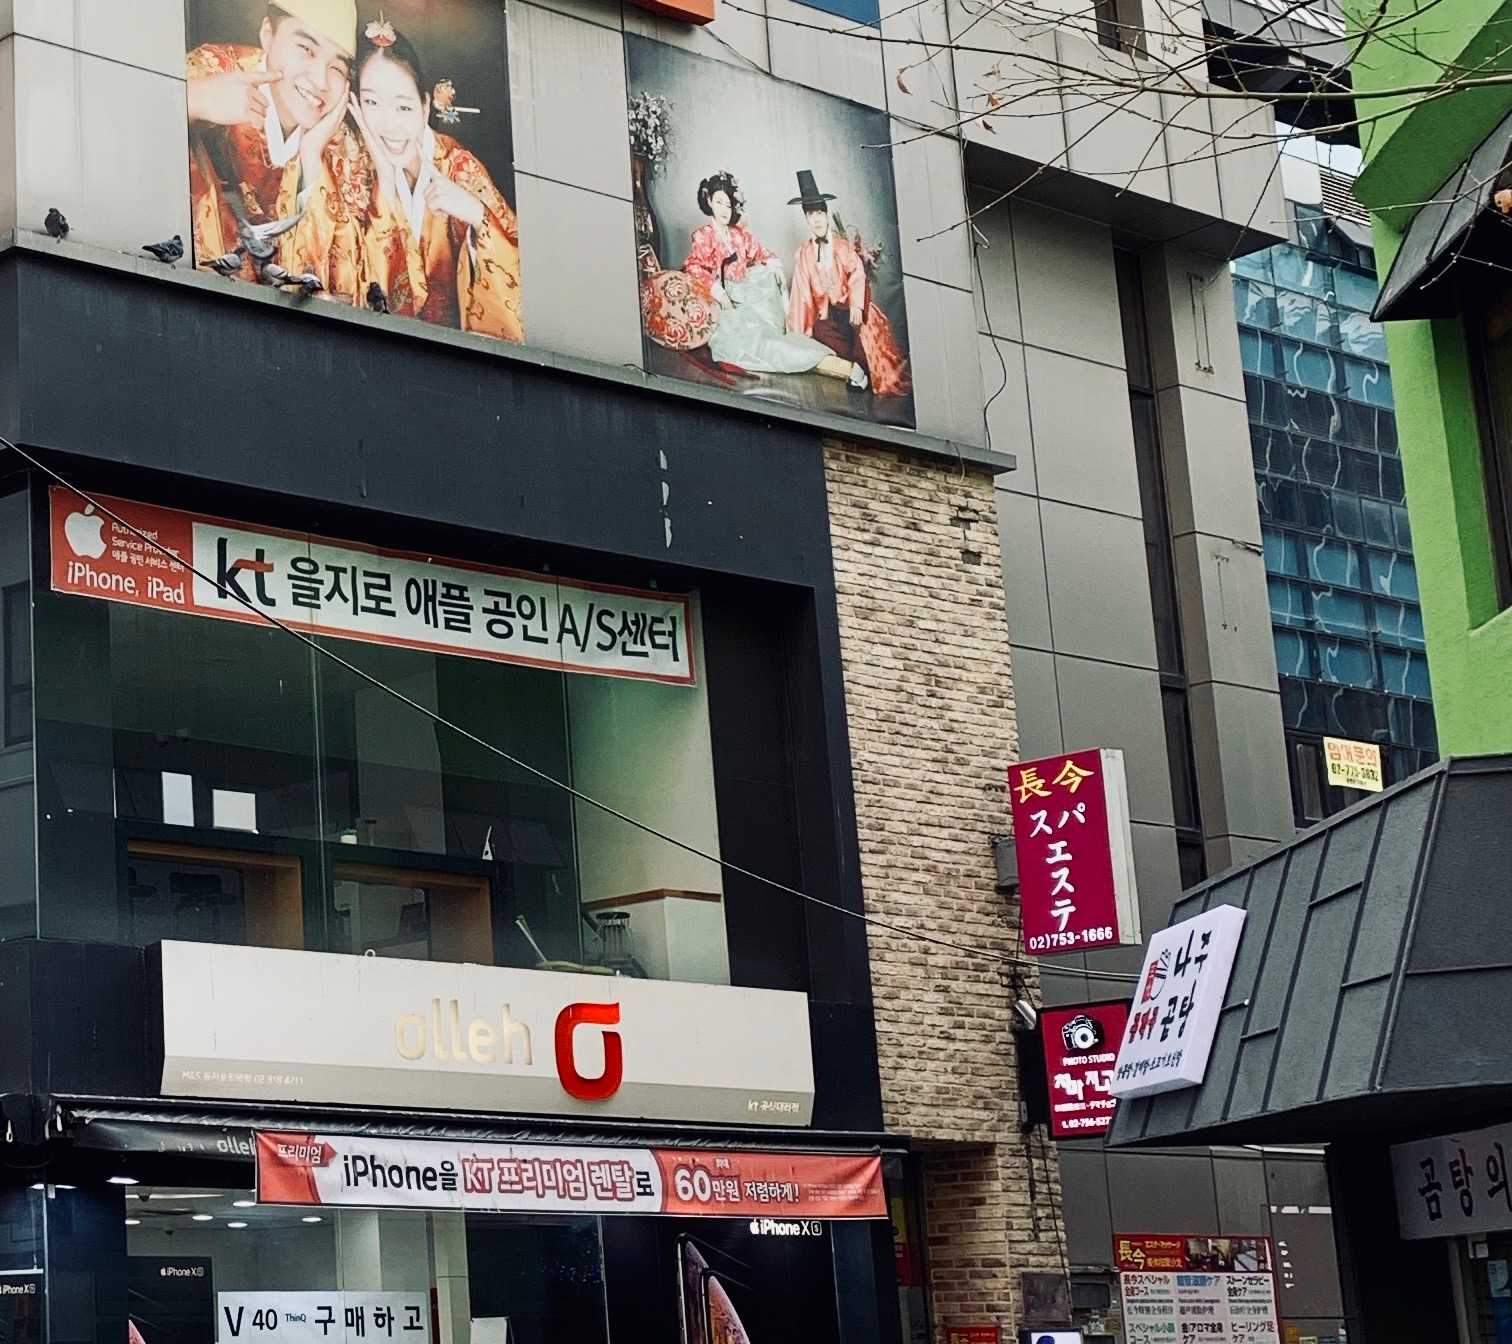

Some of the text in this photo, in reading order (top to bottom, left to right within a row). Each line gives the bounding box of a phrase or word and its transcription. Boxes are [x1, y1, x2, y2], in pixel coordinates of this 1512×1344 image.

[112, 536, 143, 552] Service
[68, 560, 186, 605] iPhone, iPad
[216, 536, 681, 663] kt 을지로 애플 공인 A/S센터
[1327, 742, 1378, 767] 임대문의
[1014, 758, 1095, 804] 長今
[1030, 925, 1114, 951] 02)753-1666
[1173, 926, 1213, 979] 나주
[1160, 979, 1197, 1043] 곰탕
[395, 998, 534, 1068] olleh
[1062, 1057, 1087, 1067] PHOTO
[276, 1143, 322, 1164] 프리미엄
[344, 1154, 654, 1200] iPhone을 KT 프리미엄 렌탈로
[674, 1167, 741, 1203] 60만원
[744, 1181, 800, 1203] 저렴하게!
[760, 1219, 801, 1236] iPhone
[166, 1267, 192, 1278] iPhone
[1, 1283, 26, 1296] iPhone
[224, 1306, 245, 1338] V
[251, 1308, 279, 1333] 40
[285, 1312, 308, 1324] ThinQ
